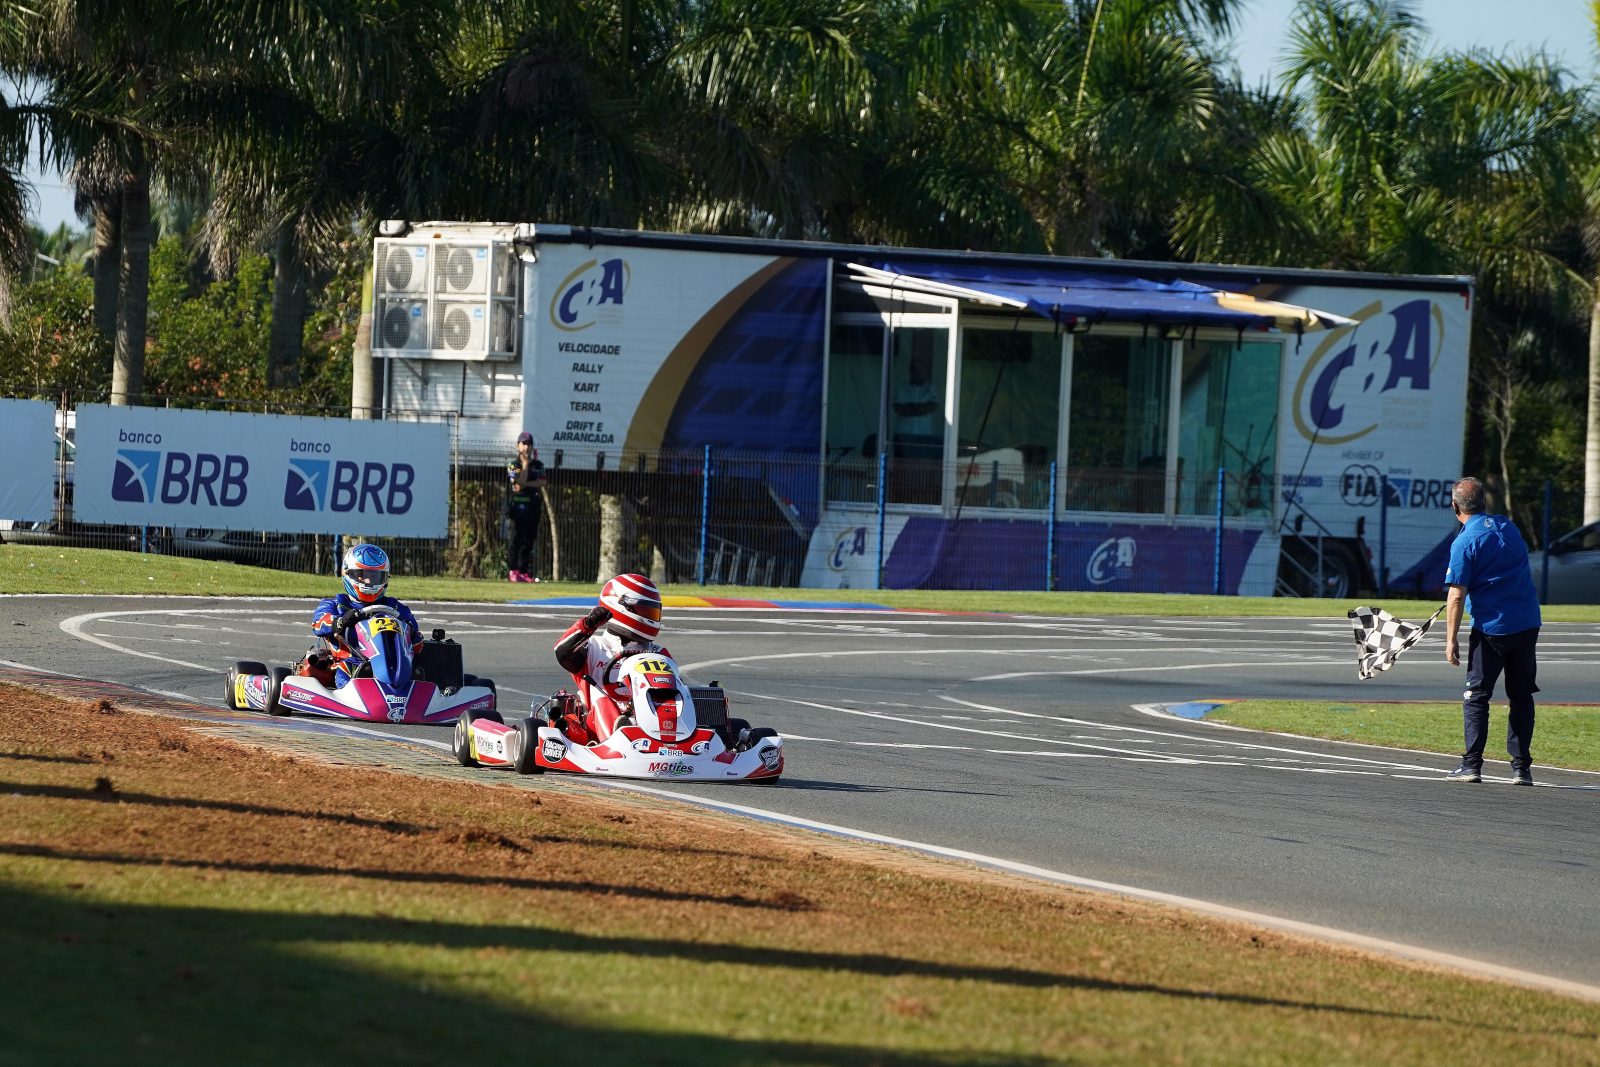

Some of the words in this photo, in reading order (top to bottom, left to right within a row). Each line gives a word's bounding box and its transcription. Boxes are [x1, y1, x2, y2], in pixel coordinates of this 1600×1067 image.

[558, 342, 621, 355] VELOCIDADE
[572, 362, 604, 374] RALLY
[573, 382, 600, 393] KART
[570, 401, 602, 413] TERRA
[566, 421, 594, 431] DRIFT
[596, 422, 603, 432] E
[119, 428, 162, 444] banco
[553, 432, 615, 444] ARRANCADA
[290, 438, 331, 453] banco
[161, 451, 249, 507] BRB
[330, 460, 415, 515] BRB
[639, 660, 673, 673] 112
